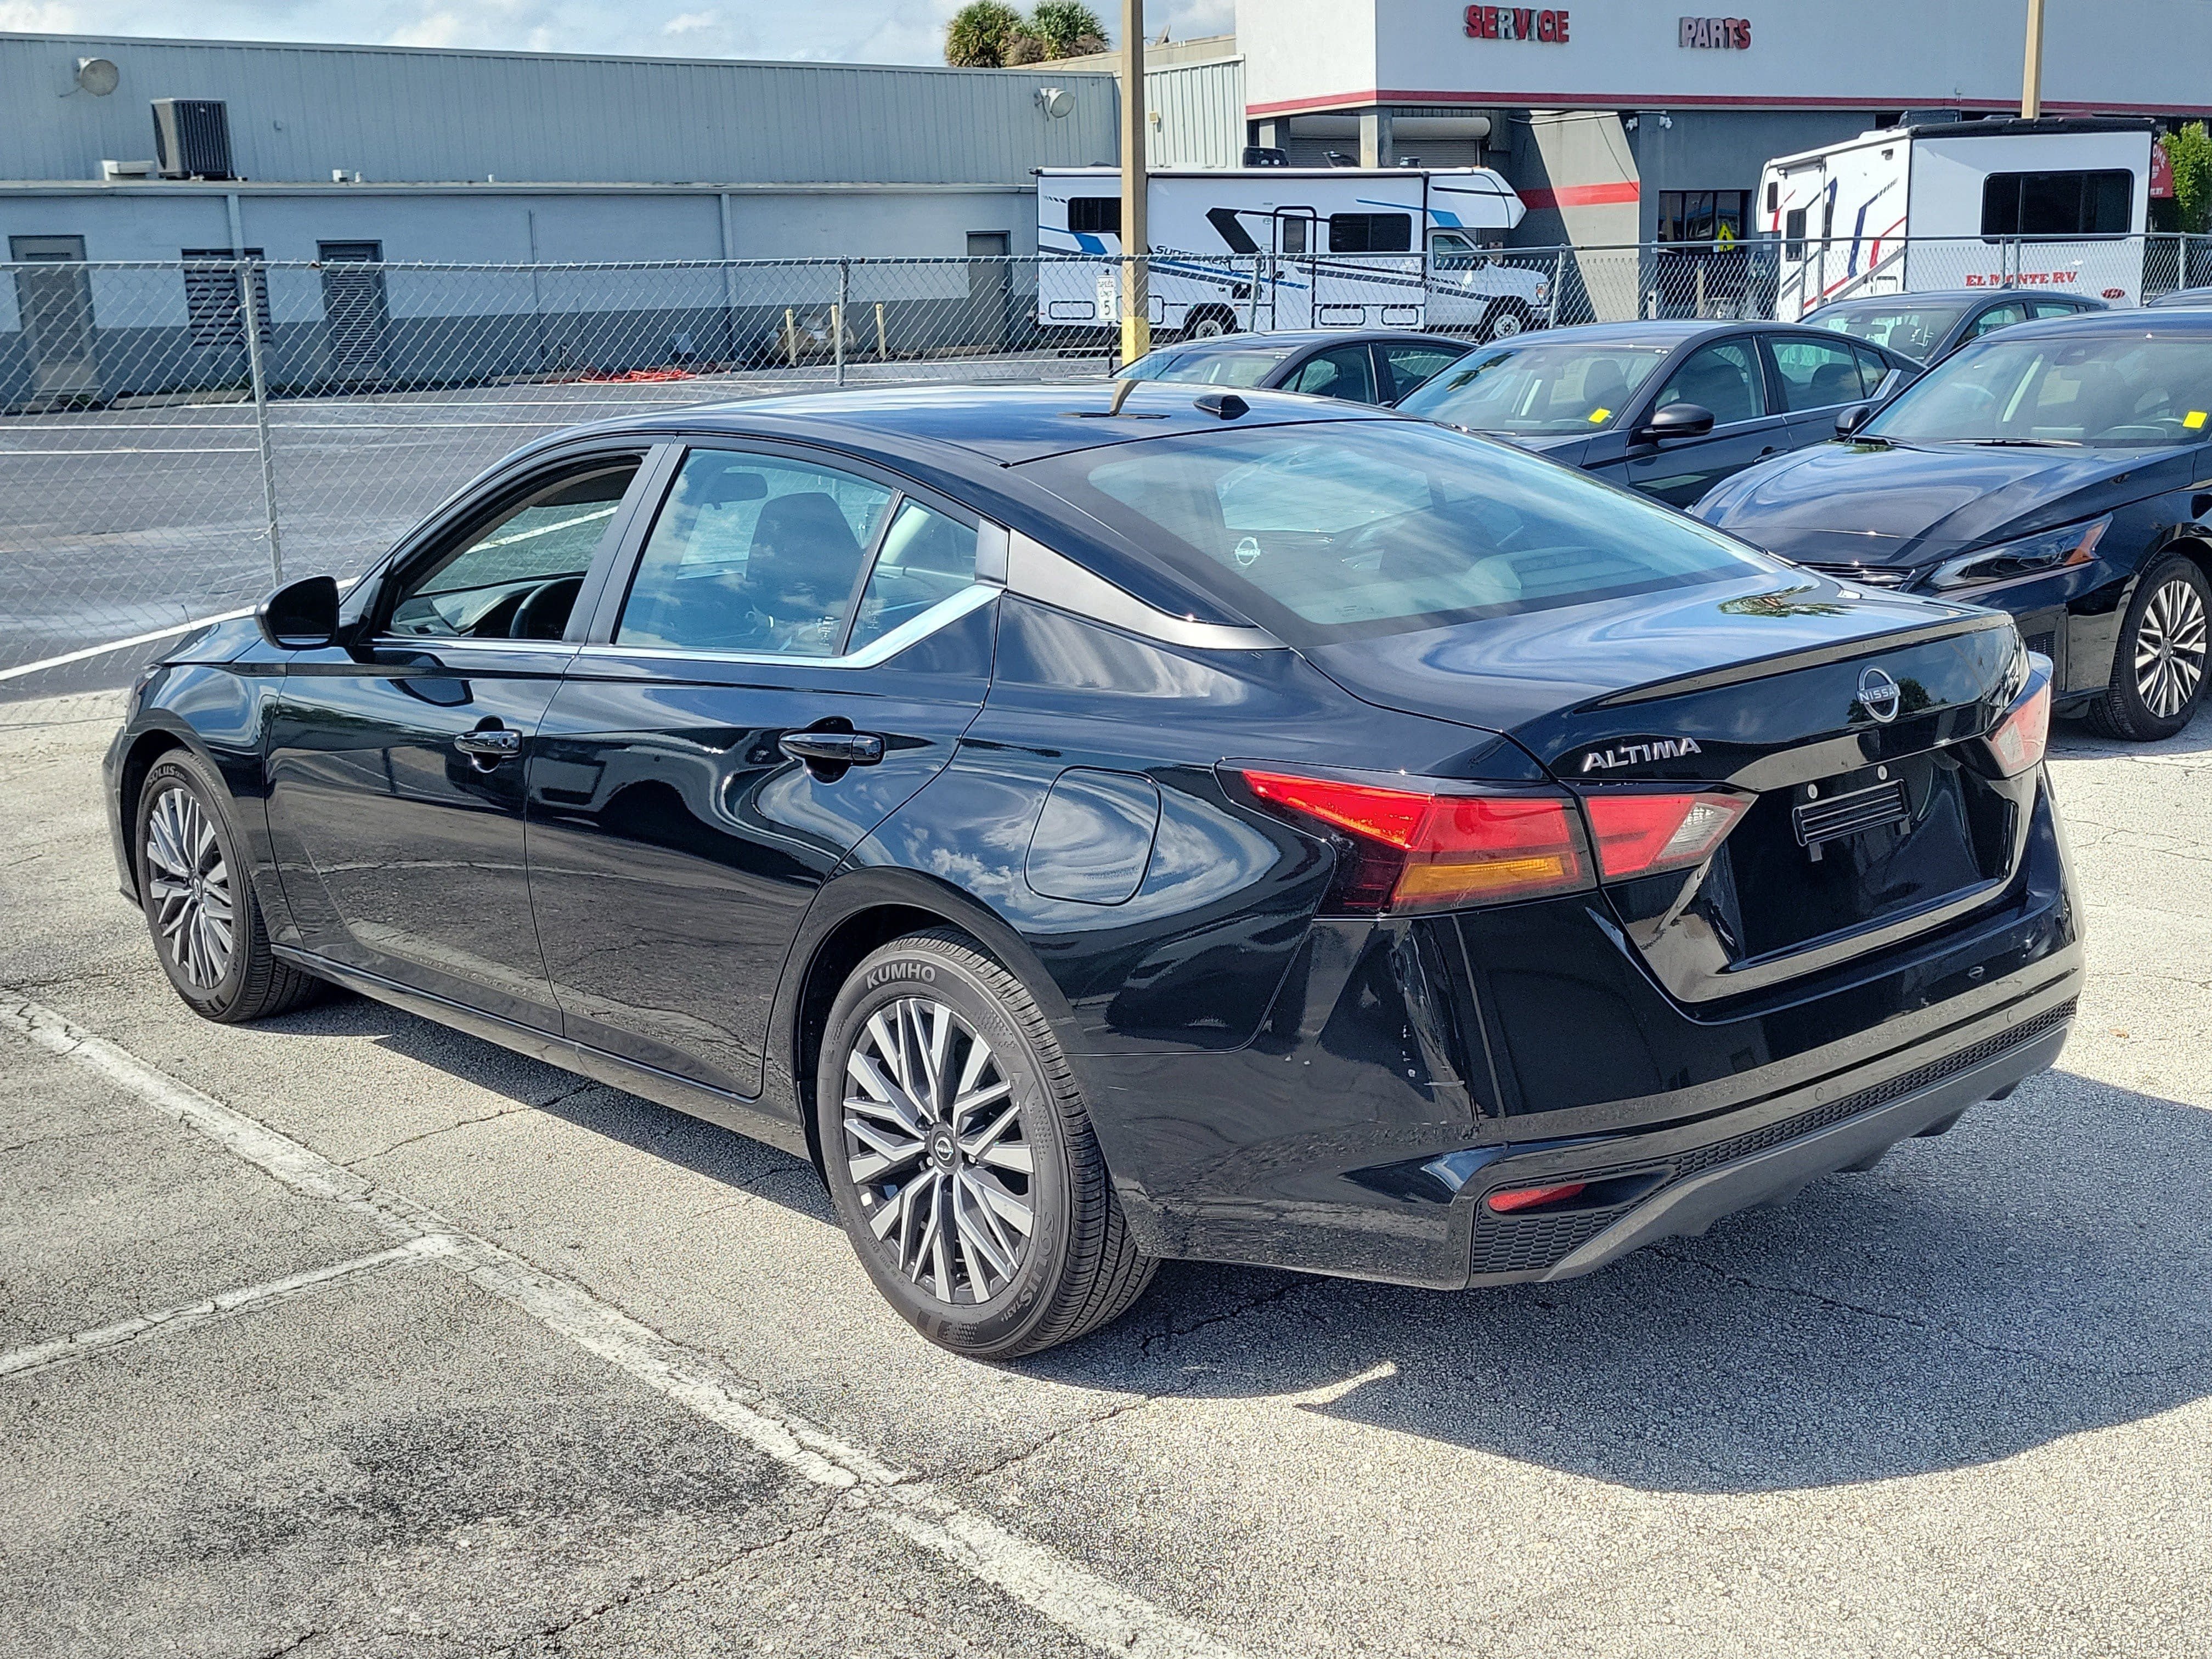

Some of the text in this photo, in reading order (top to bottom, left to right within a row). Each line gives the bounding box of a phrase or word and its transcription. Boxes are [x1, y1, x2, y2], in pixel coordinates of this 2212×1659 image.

[1463, 5, 1570, 42] SERVICE
[1679, 17, 1751, 49] PARTS
[1966, 275, 1986, 286] EL
[2052, 271, 2077, 283] RV
[1104, 300, 1111, 315] 5
[1583, 737, 1702, 772] ALTIMA
[867, 963, 935, 990] KUMHO
[1020, 1211, 1055, 1307] SOLUS
